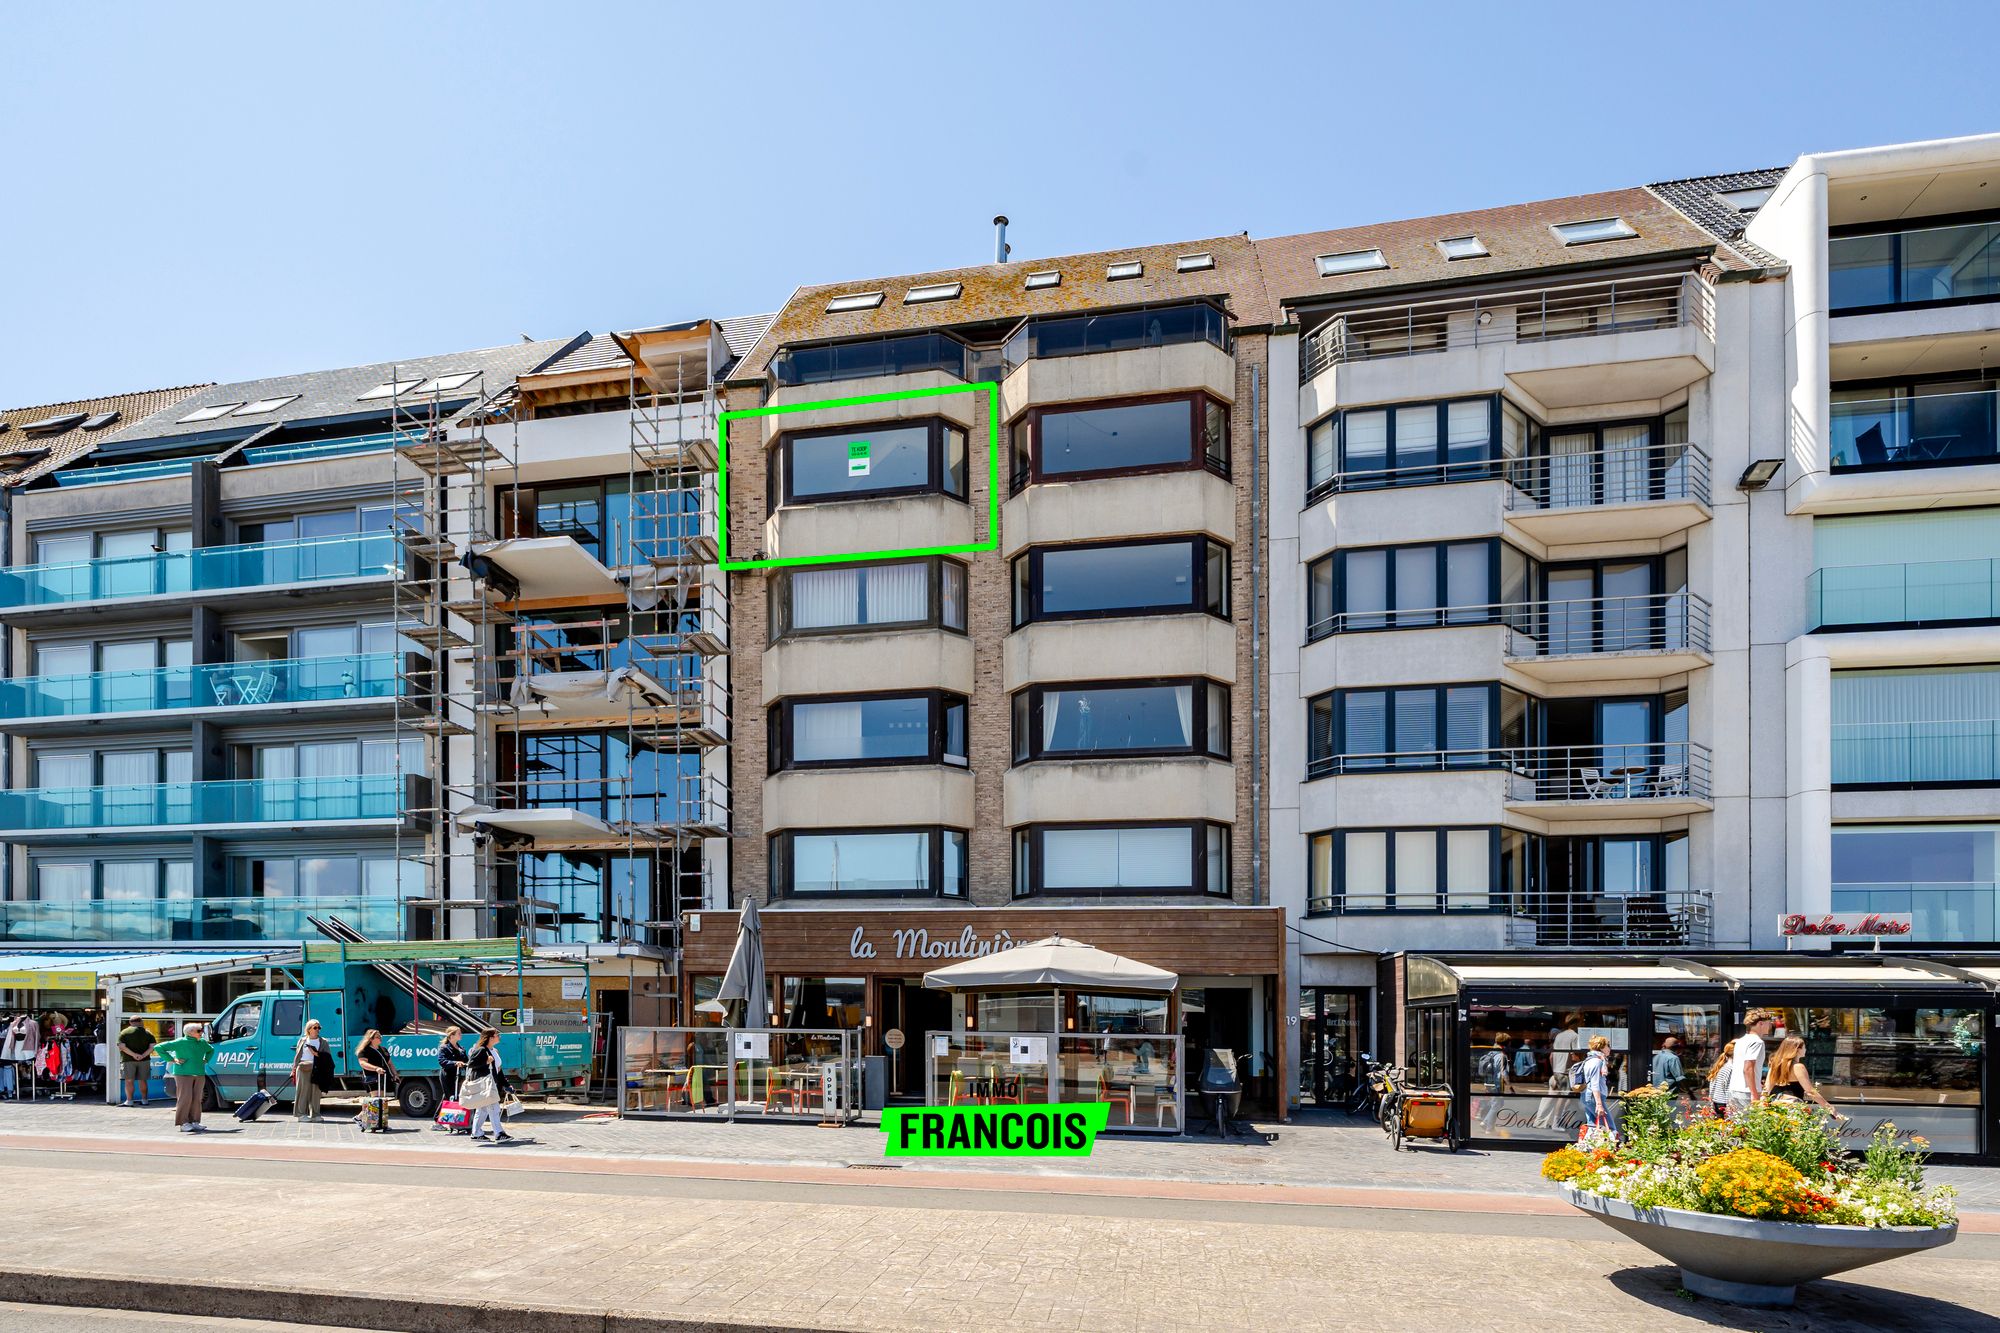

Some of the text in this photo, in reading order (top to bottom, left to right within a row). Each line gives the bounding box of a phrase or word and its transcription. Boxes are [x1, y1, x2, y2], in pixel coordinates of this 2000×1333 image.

[1783, 913, 1910, 935] Dolce Mare
[850, 925, 1028, 959] la Mouliniè
[1286, 1016, 1297, 1026] 19
[536, 1036, 557, 1048] MADY
[387, 1045, 438, 1058] lles voo
[216, 1052, 254, 1068] MADY
[1496, 1108, 1583, 1129] Dol Ma
